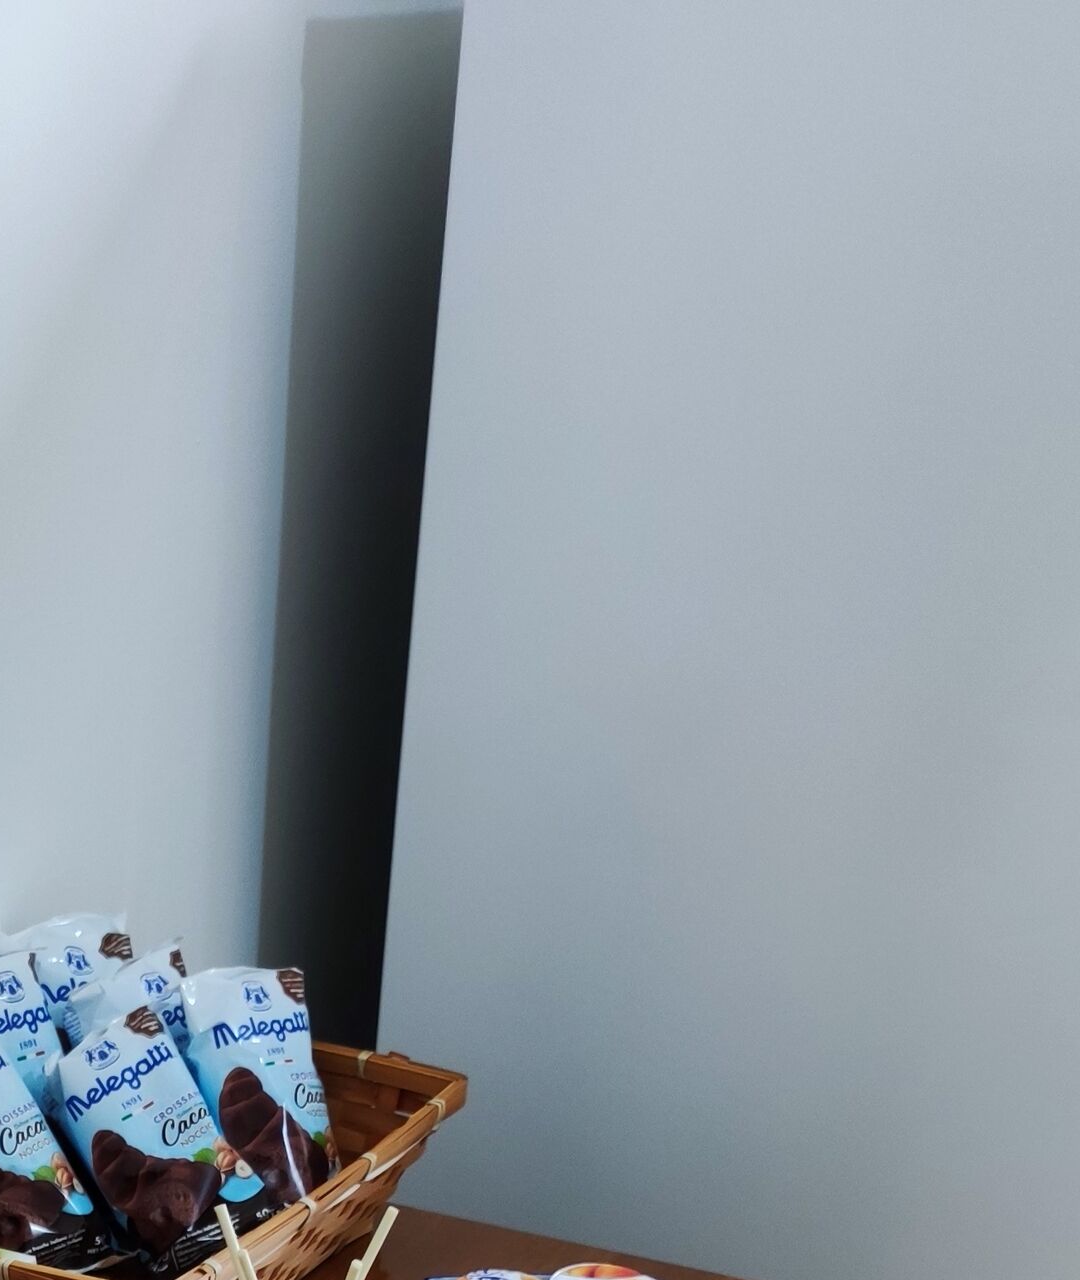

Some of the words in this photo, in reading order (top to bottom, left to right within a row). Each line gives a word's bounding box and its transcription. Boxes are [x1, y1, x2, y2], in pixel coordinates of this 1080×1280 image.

[213, 1011, 309, 1050] Melegatti
[65, 1041, 174, 1122] Melegatti
[121, 1094, 143, 1110] 1891
[153, 1091, 199, 1124] CROISSA
[161, 1107, 209, 1147] Caca
